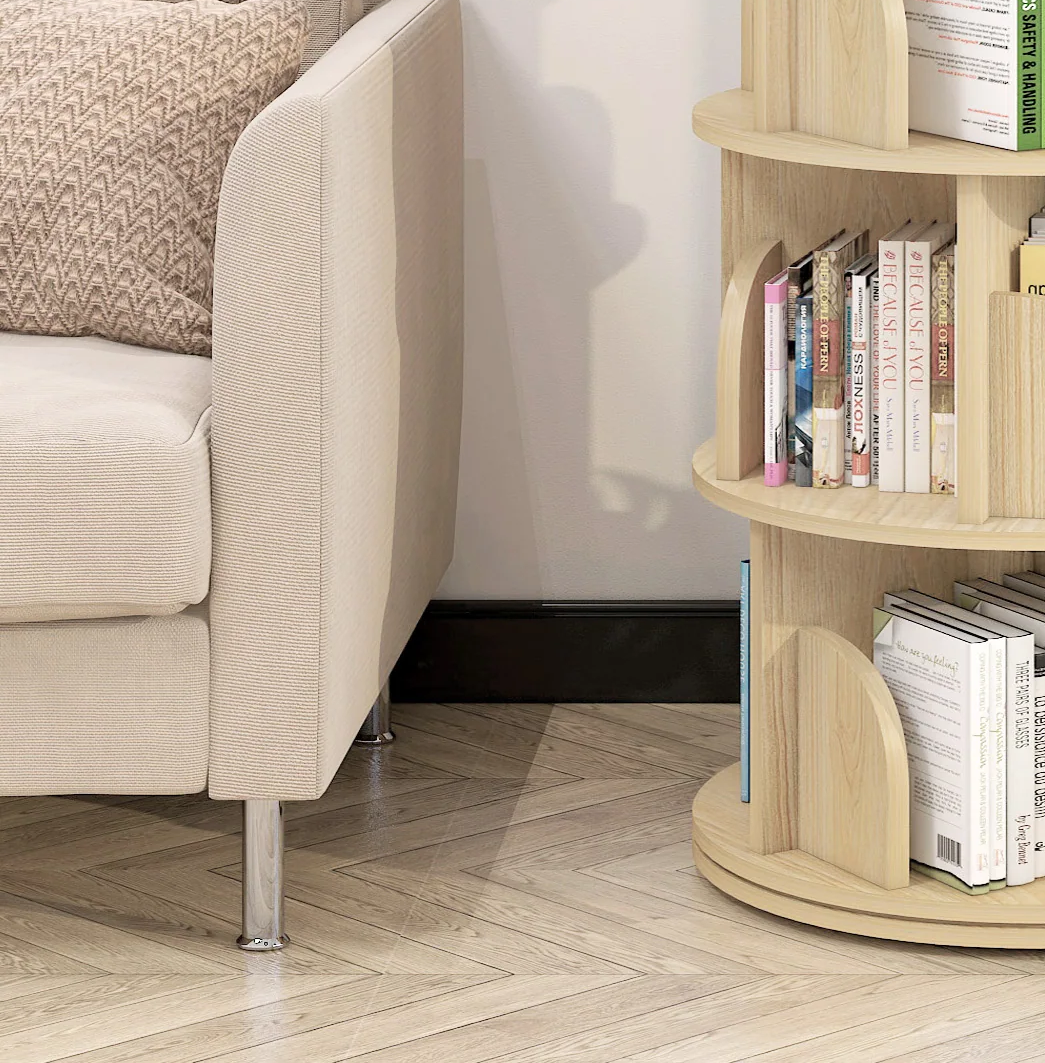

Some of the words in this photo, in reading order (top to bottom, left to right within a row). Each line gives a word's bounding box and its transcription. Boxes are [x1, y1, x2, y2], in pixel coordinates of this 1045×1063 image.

[1021, 15, 1037, 57] SAFETY
[1021, 61, 1037, 71] &
[1021, 74, 1037, 135] HANDLING
[820, 256, 830, 279] THE
[939, 260, 949, 282] THE
[820, 281, 830, 323] PEOPLE
[883, 264, 898, 337] BECAUSE
[909, 264, 925, 337] BECAUSE
[939, 284, 949, 327] PEOPLE
[820, 324, 830, 340] OF
[939, 328, 949, 344] OF
[820, 341, 830, 373] PERN
[873, 350, 880, 361] OF
[883, 340, 895, 351] of
[910, 341, 922, 351] of
[883, 354, 898, 390] YOU
[939, 345, 949, 377] PERN
[909, 355, 925, 391] YOU
[1015, 661, 1030, 683] THREE
[1015, 685, 1030, 706] PAIRS
[1015, 707, 1030, 717] OF
[1015, 718, 1030, 749] GLASSES
[1016, 815, 1031, 823] by
[1016, 824, 1031, 841] Greg
[1016, 842, 1031, 865] Bennet
